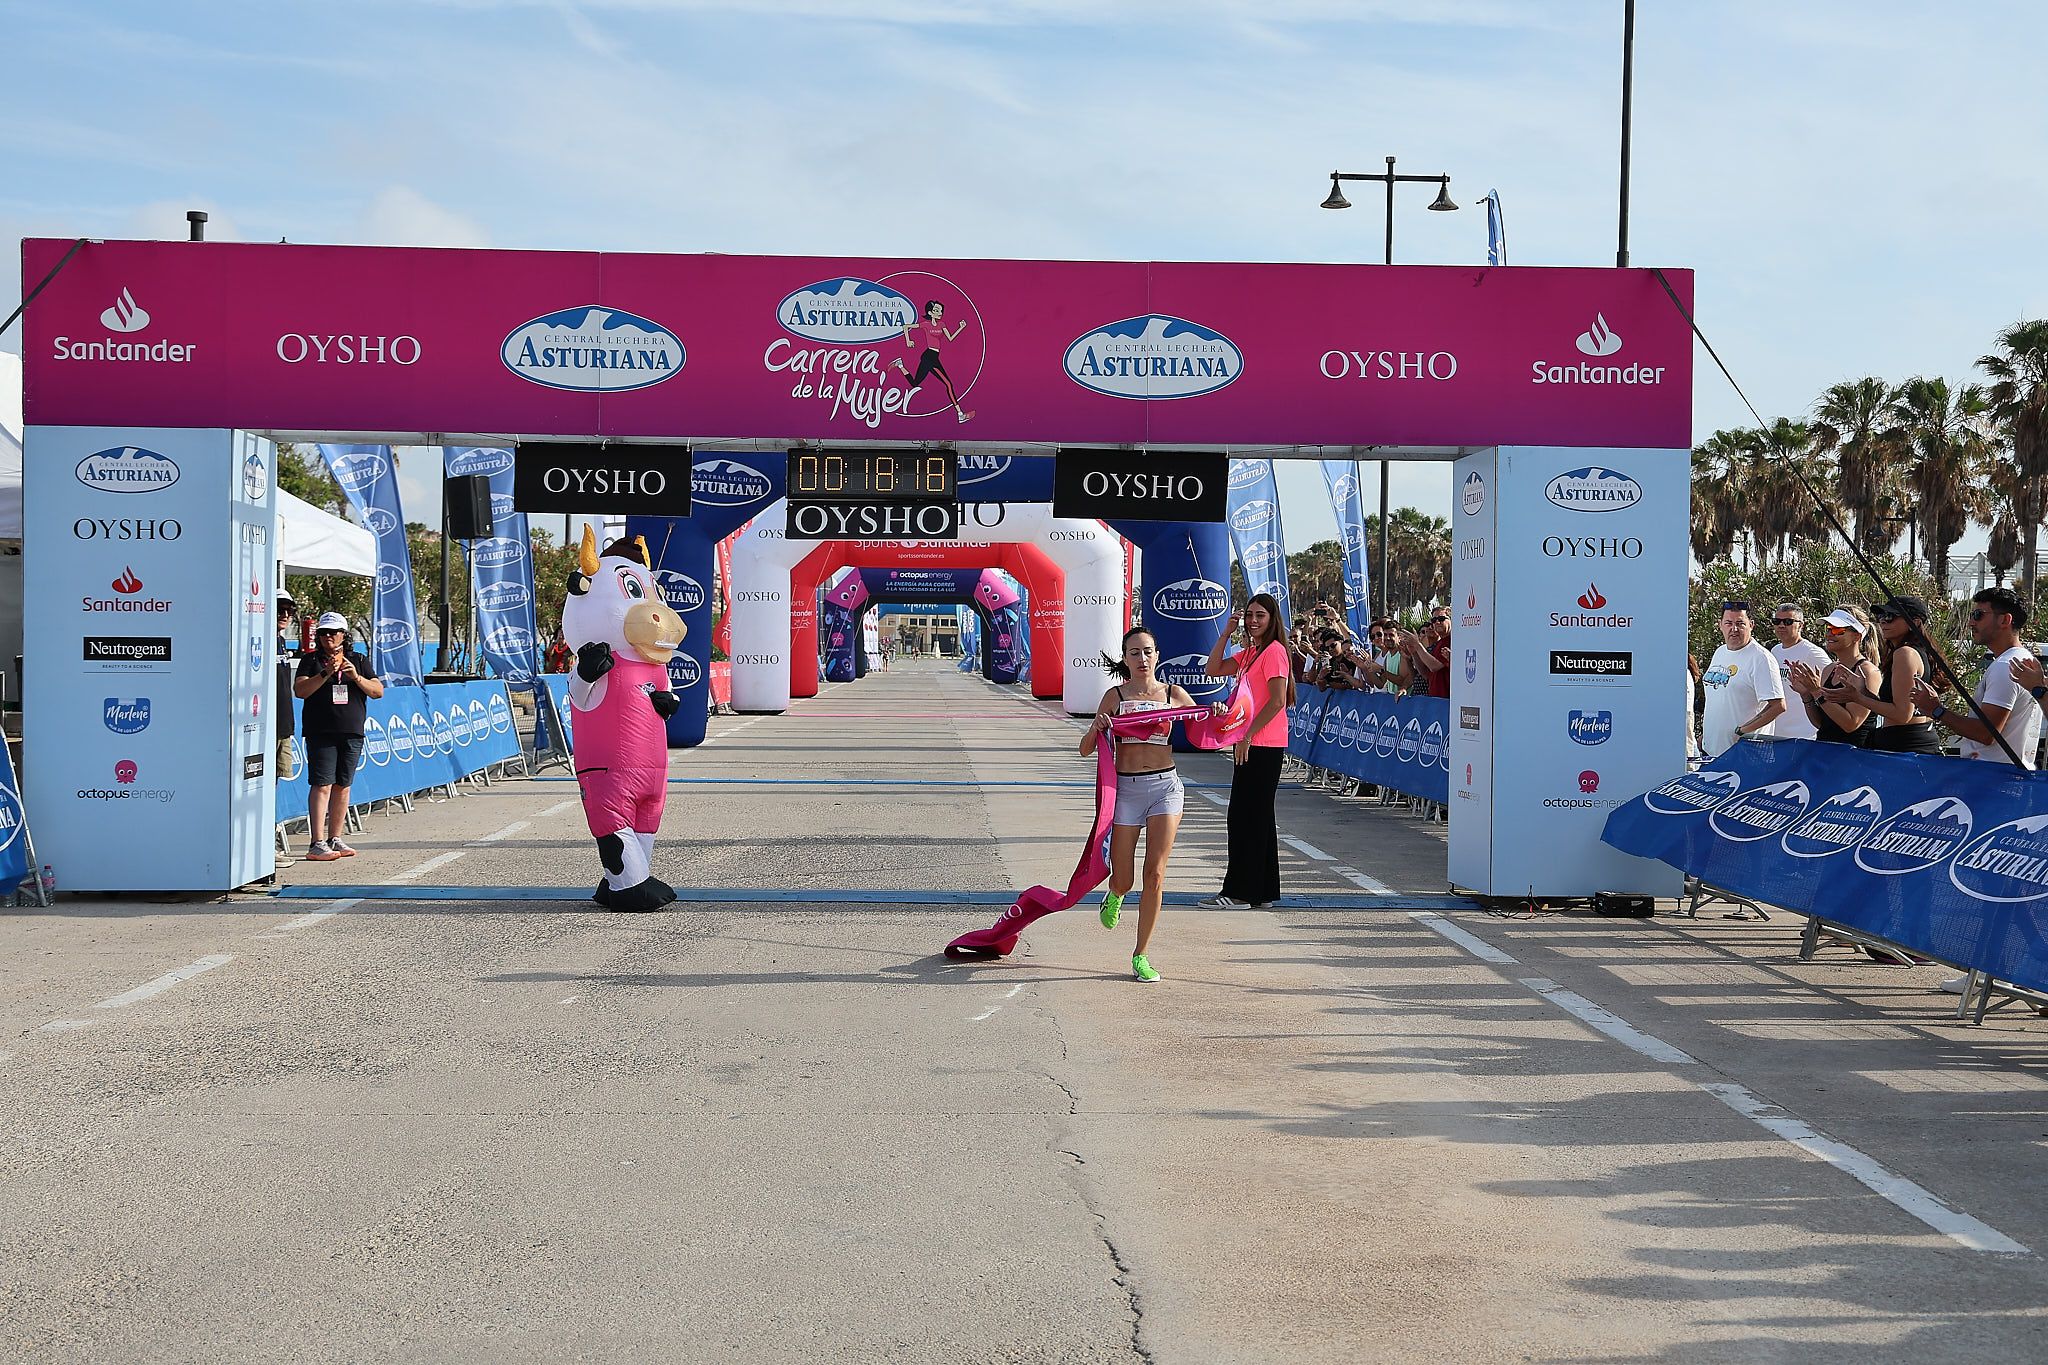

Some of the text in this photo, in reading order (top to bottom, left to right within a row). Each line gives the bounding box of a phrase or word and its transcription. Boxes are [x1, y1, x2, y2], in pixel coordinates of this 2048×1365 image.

[788, 301, 904, 328] ASTURIANA
[53, 336, 196, 362] Santander
[277, 333, 422, 365] OYSHO
[544, 334, 666, 345] CENTRAL LECHERA
[1105, 344, 1224, 353] CENTRAL LECHERA
[515, 336, 672, 370] ASTURIANA
[764, 338, 879, 374] Carrera
[1077, 345, 1230, 378] ASTURIANA
[1319, 350, 1458, 380] OYSHO
[1532, 360, 1666, 384] Santander
[792, 370, 922, 429] de la Mujer
[83, 462, 173, 482] ASTURIANA
[543, 467, 666, 496] OYSHO
[691, 479, 764, 496] STURIANA
[1083, 471, 1204, 501] OYSHO
[1551, 482, 1636, 501] ASTURIANA
[73, 517, 182, 541] OYSHO
[795, 505, 950, 536] OYSHO
[758, 529, 786, 539] OYS
[1049, 530, 1096, 541] OYSHO
[1460, 537, 1485, 561] OYSHO
[1542, 536, 1643, 559] OYSHO
[899, 571, 953, 580] octopus energy
[82, 597, 173, 612] Santander
[737, 591, 781, 602] OYSHO
[1072, 594, 1117, 606] OYSHO
[1158, 593, 1226, 611] ASTURIANA
[1549, 612, 1634, 628] Santander
[89, 641, 167, 659] Neutrogena
[736, 654, 779, 665] OYSHO
[1555, 655, 1627, 673] Neutrogena
[106, 704, 149, 725] Marlene
[1570, 717, 1610, 737] Marlene
[77, 788, 176, 803] octopus energy
[1542, 797, 1628, 811] octopus ener
[1717, 795, 1790, 831] ASTURIANA
[1790, 811, 1864, 845] ASTURIANA
[1861, 820, 1952, 860] ASTURIANA
[1956, 835, 2048, 886] ASTURIAN
